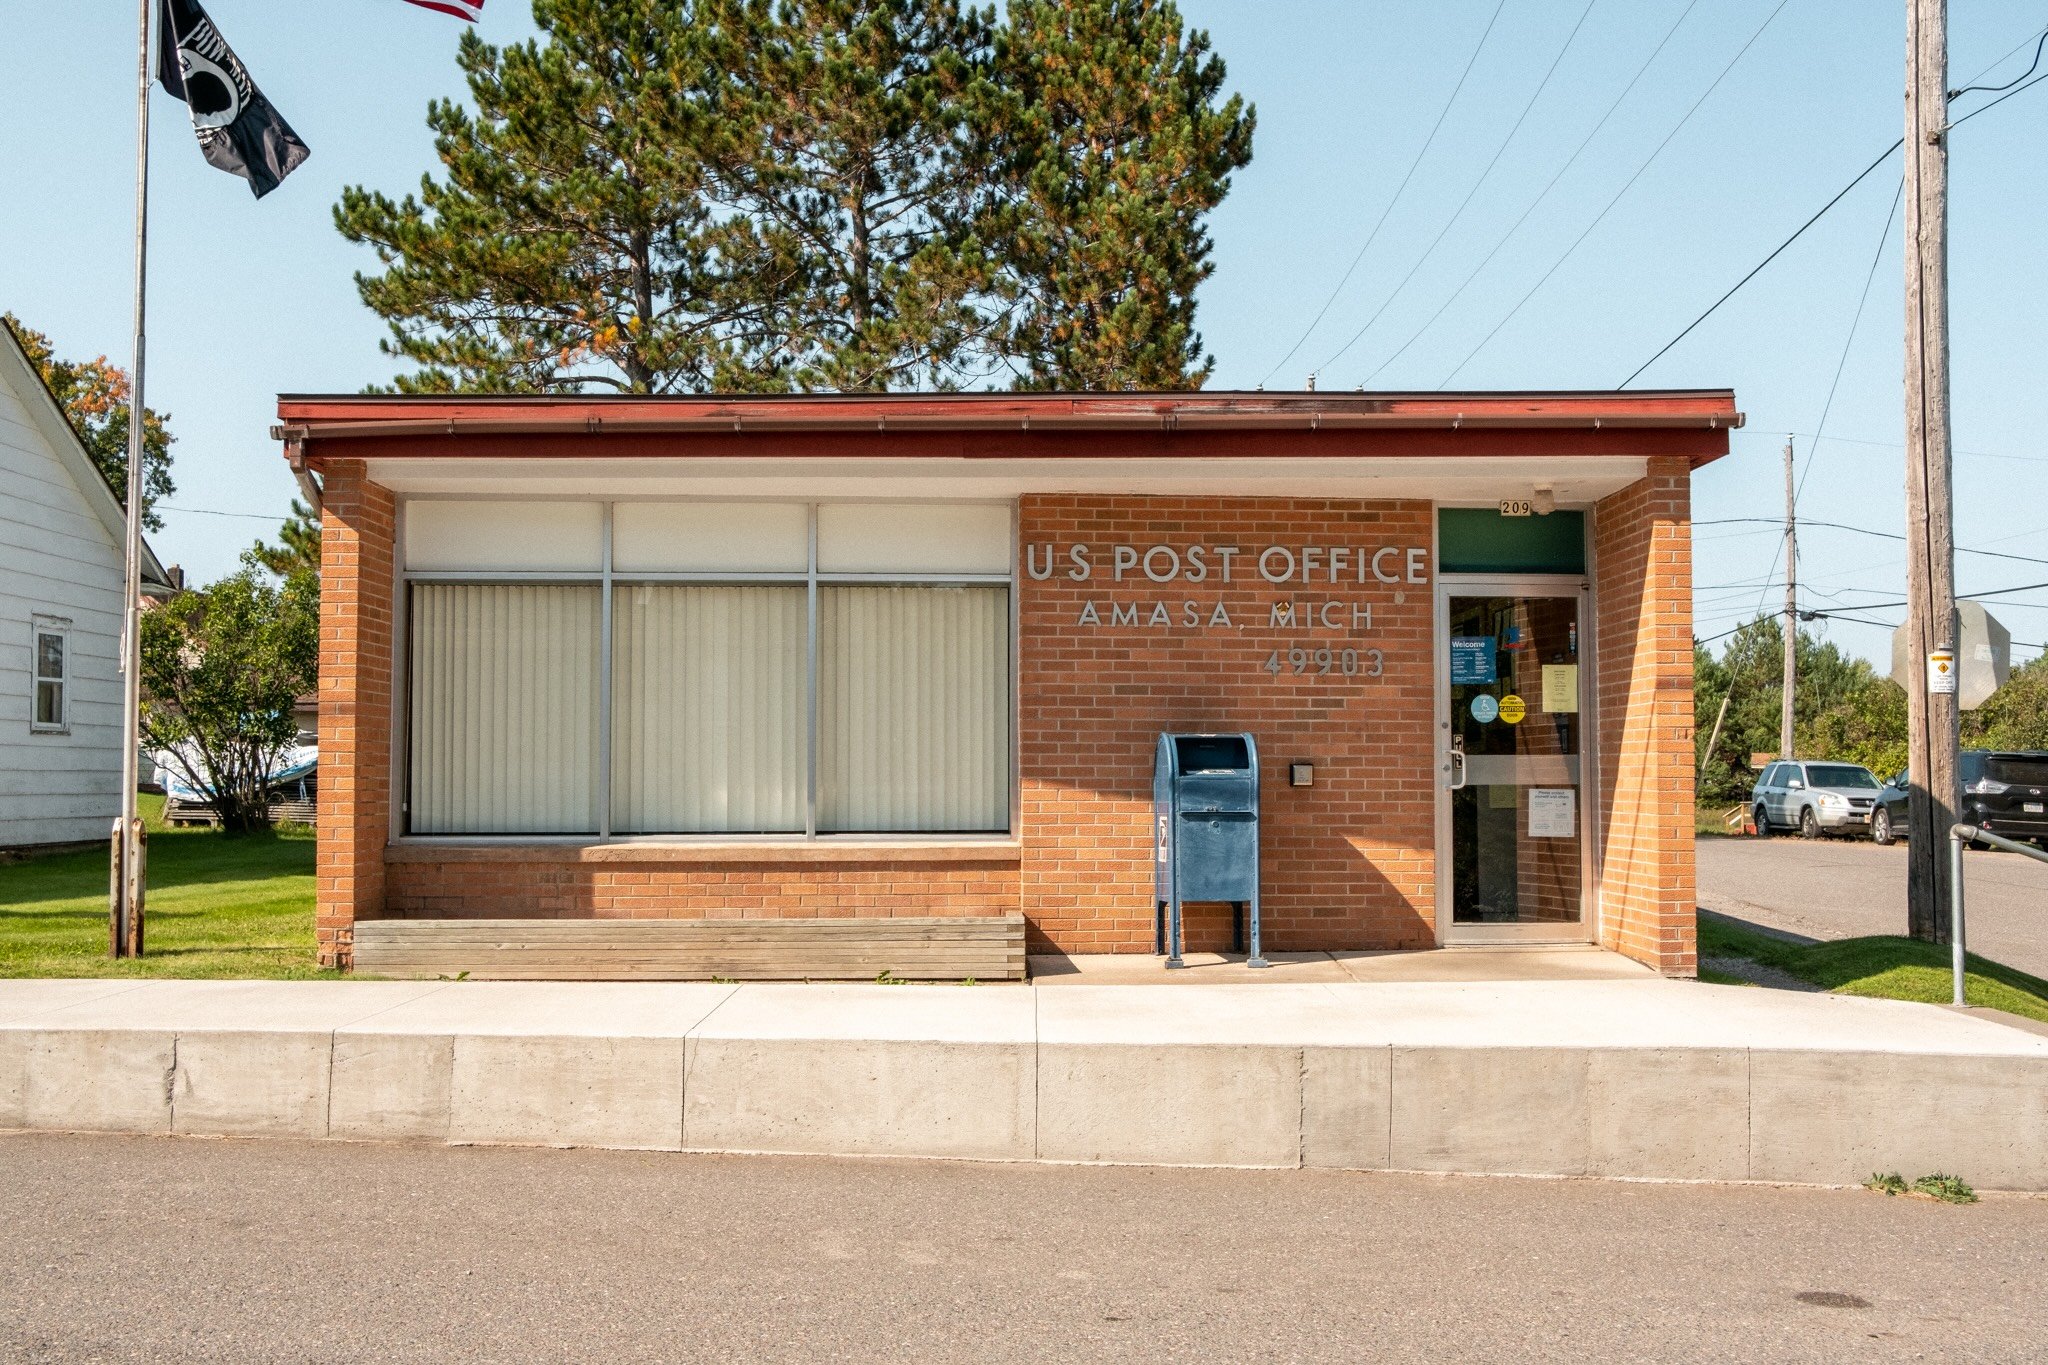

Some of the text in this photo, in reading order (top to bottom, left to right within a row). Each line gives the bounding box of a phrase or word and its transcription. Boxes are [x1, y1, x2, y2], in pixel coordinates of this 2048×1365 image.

[1503, 502, 1529, 514] 209
[1115, 546, 1240, 584] POST
[1259, 546, 1428, 584] OFFICE
[1269, 601, 1372, 630] MICH
[1264, 648, 1384, 677] 49903
